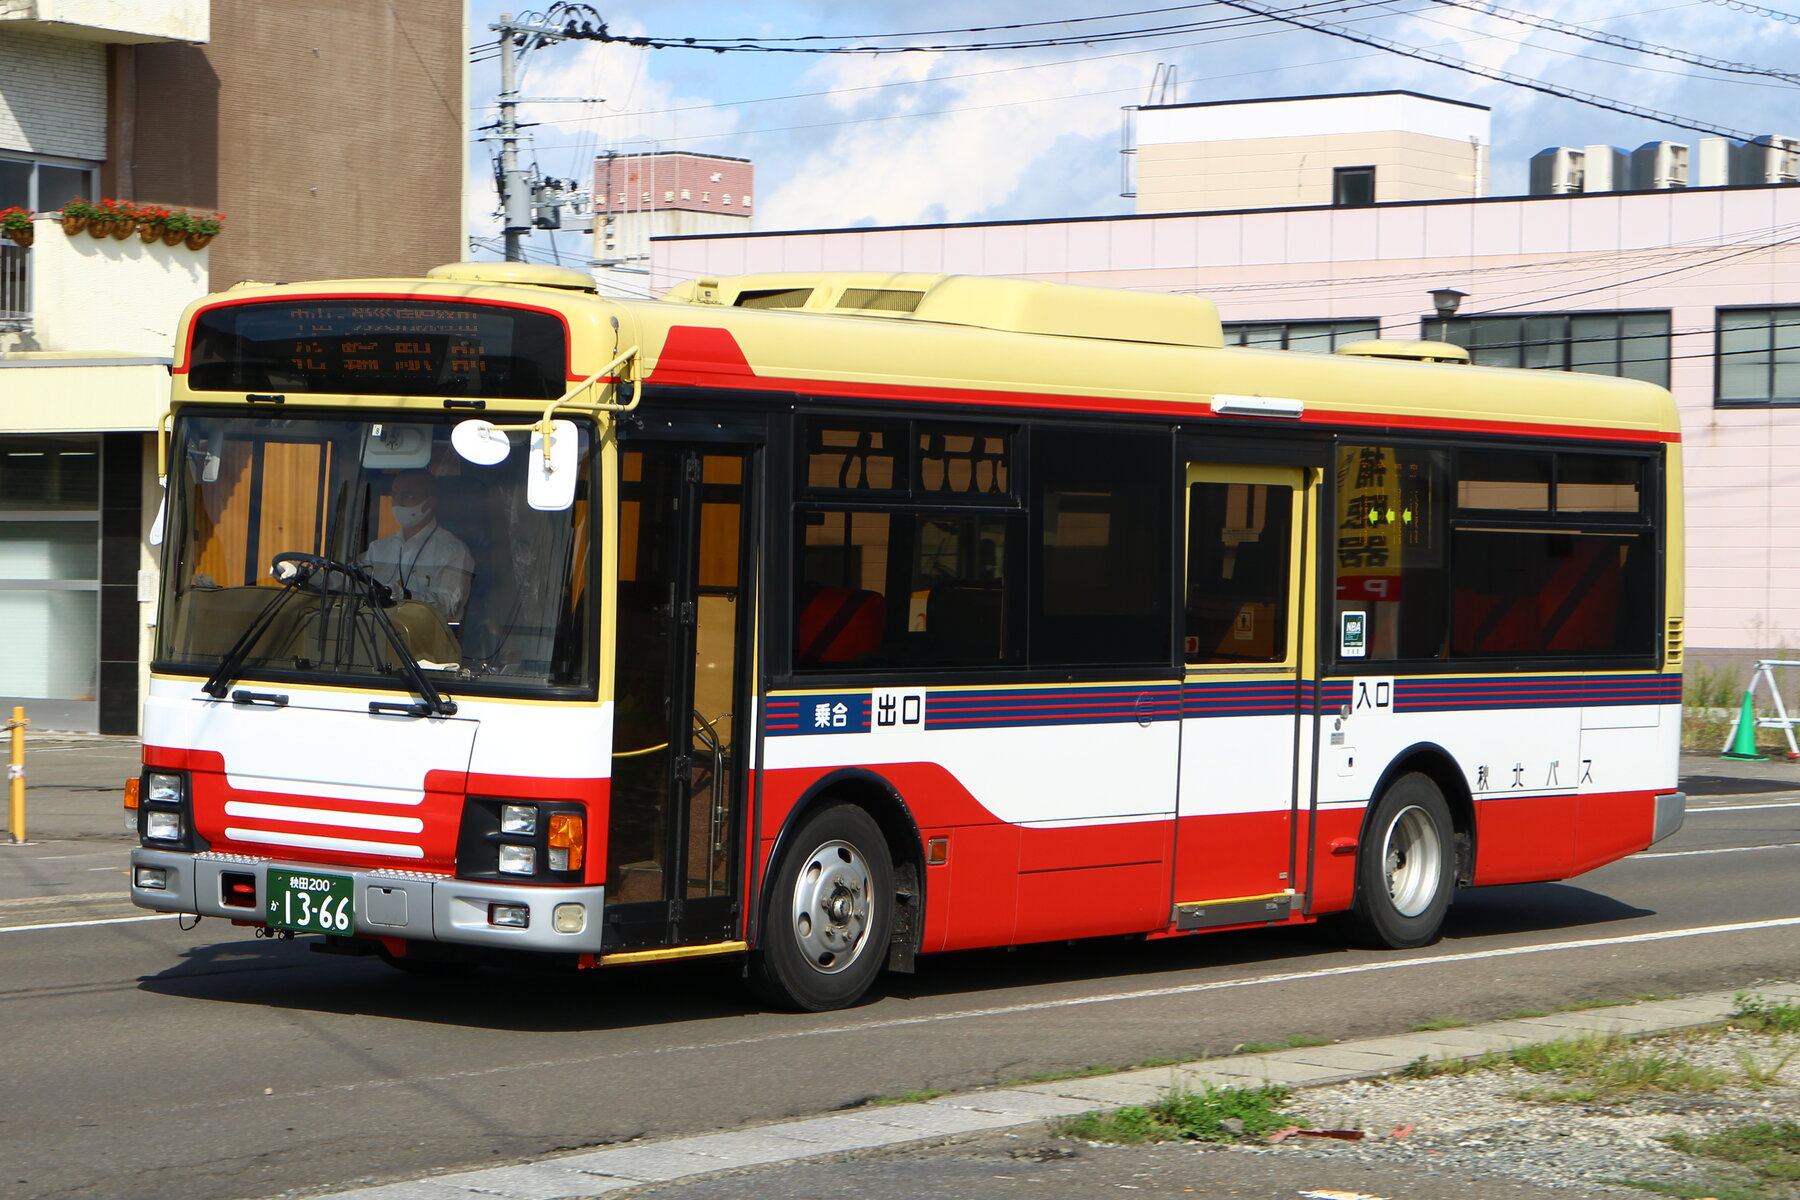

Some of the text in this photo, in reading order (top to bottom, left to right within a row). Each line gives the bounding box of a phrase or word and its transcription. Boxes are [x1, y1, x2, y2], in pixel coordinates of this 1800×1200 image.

[1346, 621, 1361, 632] NBA
[1356, 681, 1390, 709] 入口
[814, 702, 848, 729] 乗合
[877, 694, 921, 727] 出口
[289, 876, 330, 892] 秋田200
[270, 890, 349, 931] か 13-66
